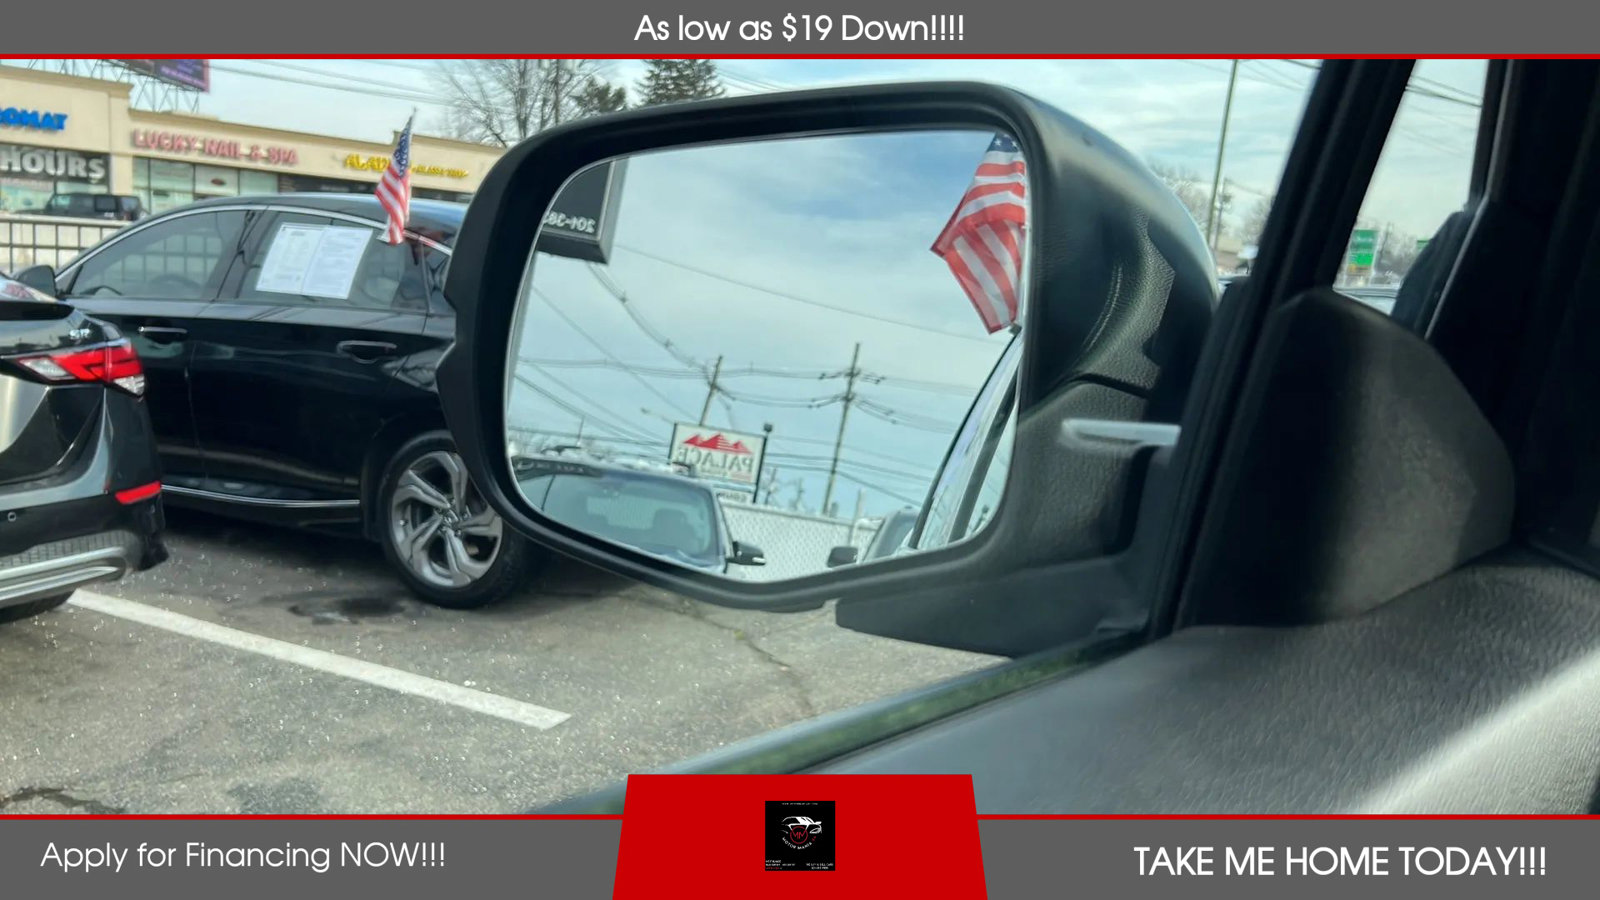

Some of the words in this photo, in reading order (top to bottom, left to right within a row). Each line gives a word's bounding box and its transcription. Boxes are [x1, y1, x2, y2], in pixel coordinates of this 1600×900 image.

[0, 146, 106, 179] HOURS
[133, 130, 199, 152] LUCKY
[203, 138, 243, 158] NAIL
[268, 147, 299, 165] SPA
